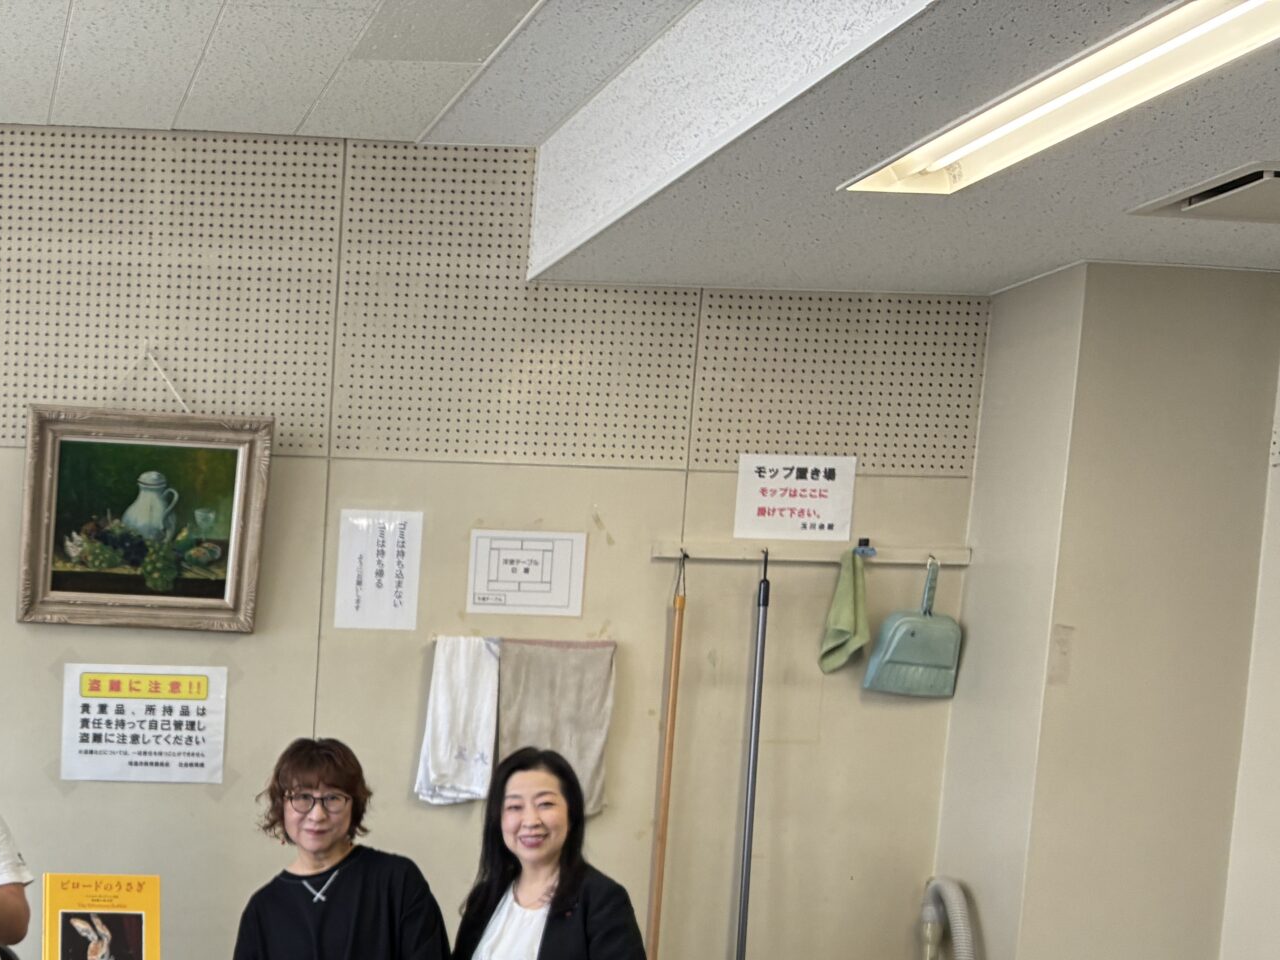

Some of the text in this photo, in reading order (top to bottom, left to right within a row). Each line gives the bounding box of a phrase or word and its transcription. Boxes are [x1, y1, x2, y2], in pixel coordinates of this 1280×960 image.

[754, 466, 836, 481] モップ置き場
[759, 487, 829, 499] モップはここに
[79, 703, 207, 717] 貴重品、所持品は
[79, 717, 206, 732] 責任を持って自己管理し
[78, 732, 206, 746] 盗難に注意してください
[60, 879, 146, 893] ビロードのうさぎ
